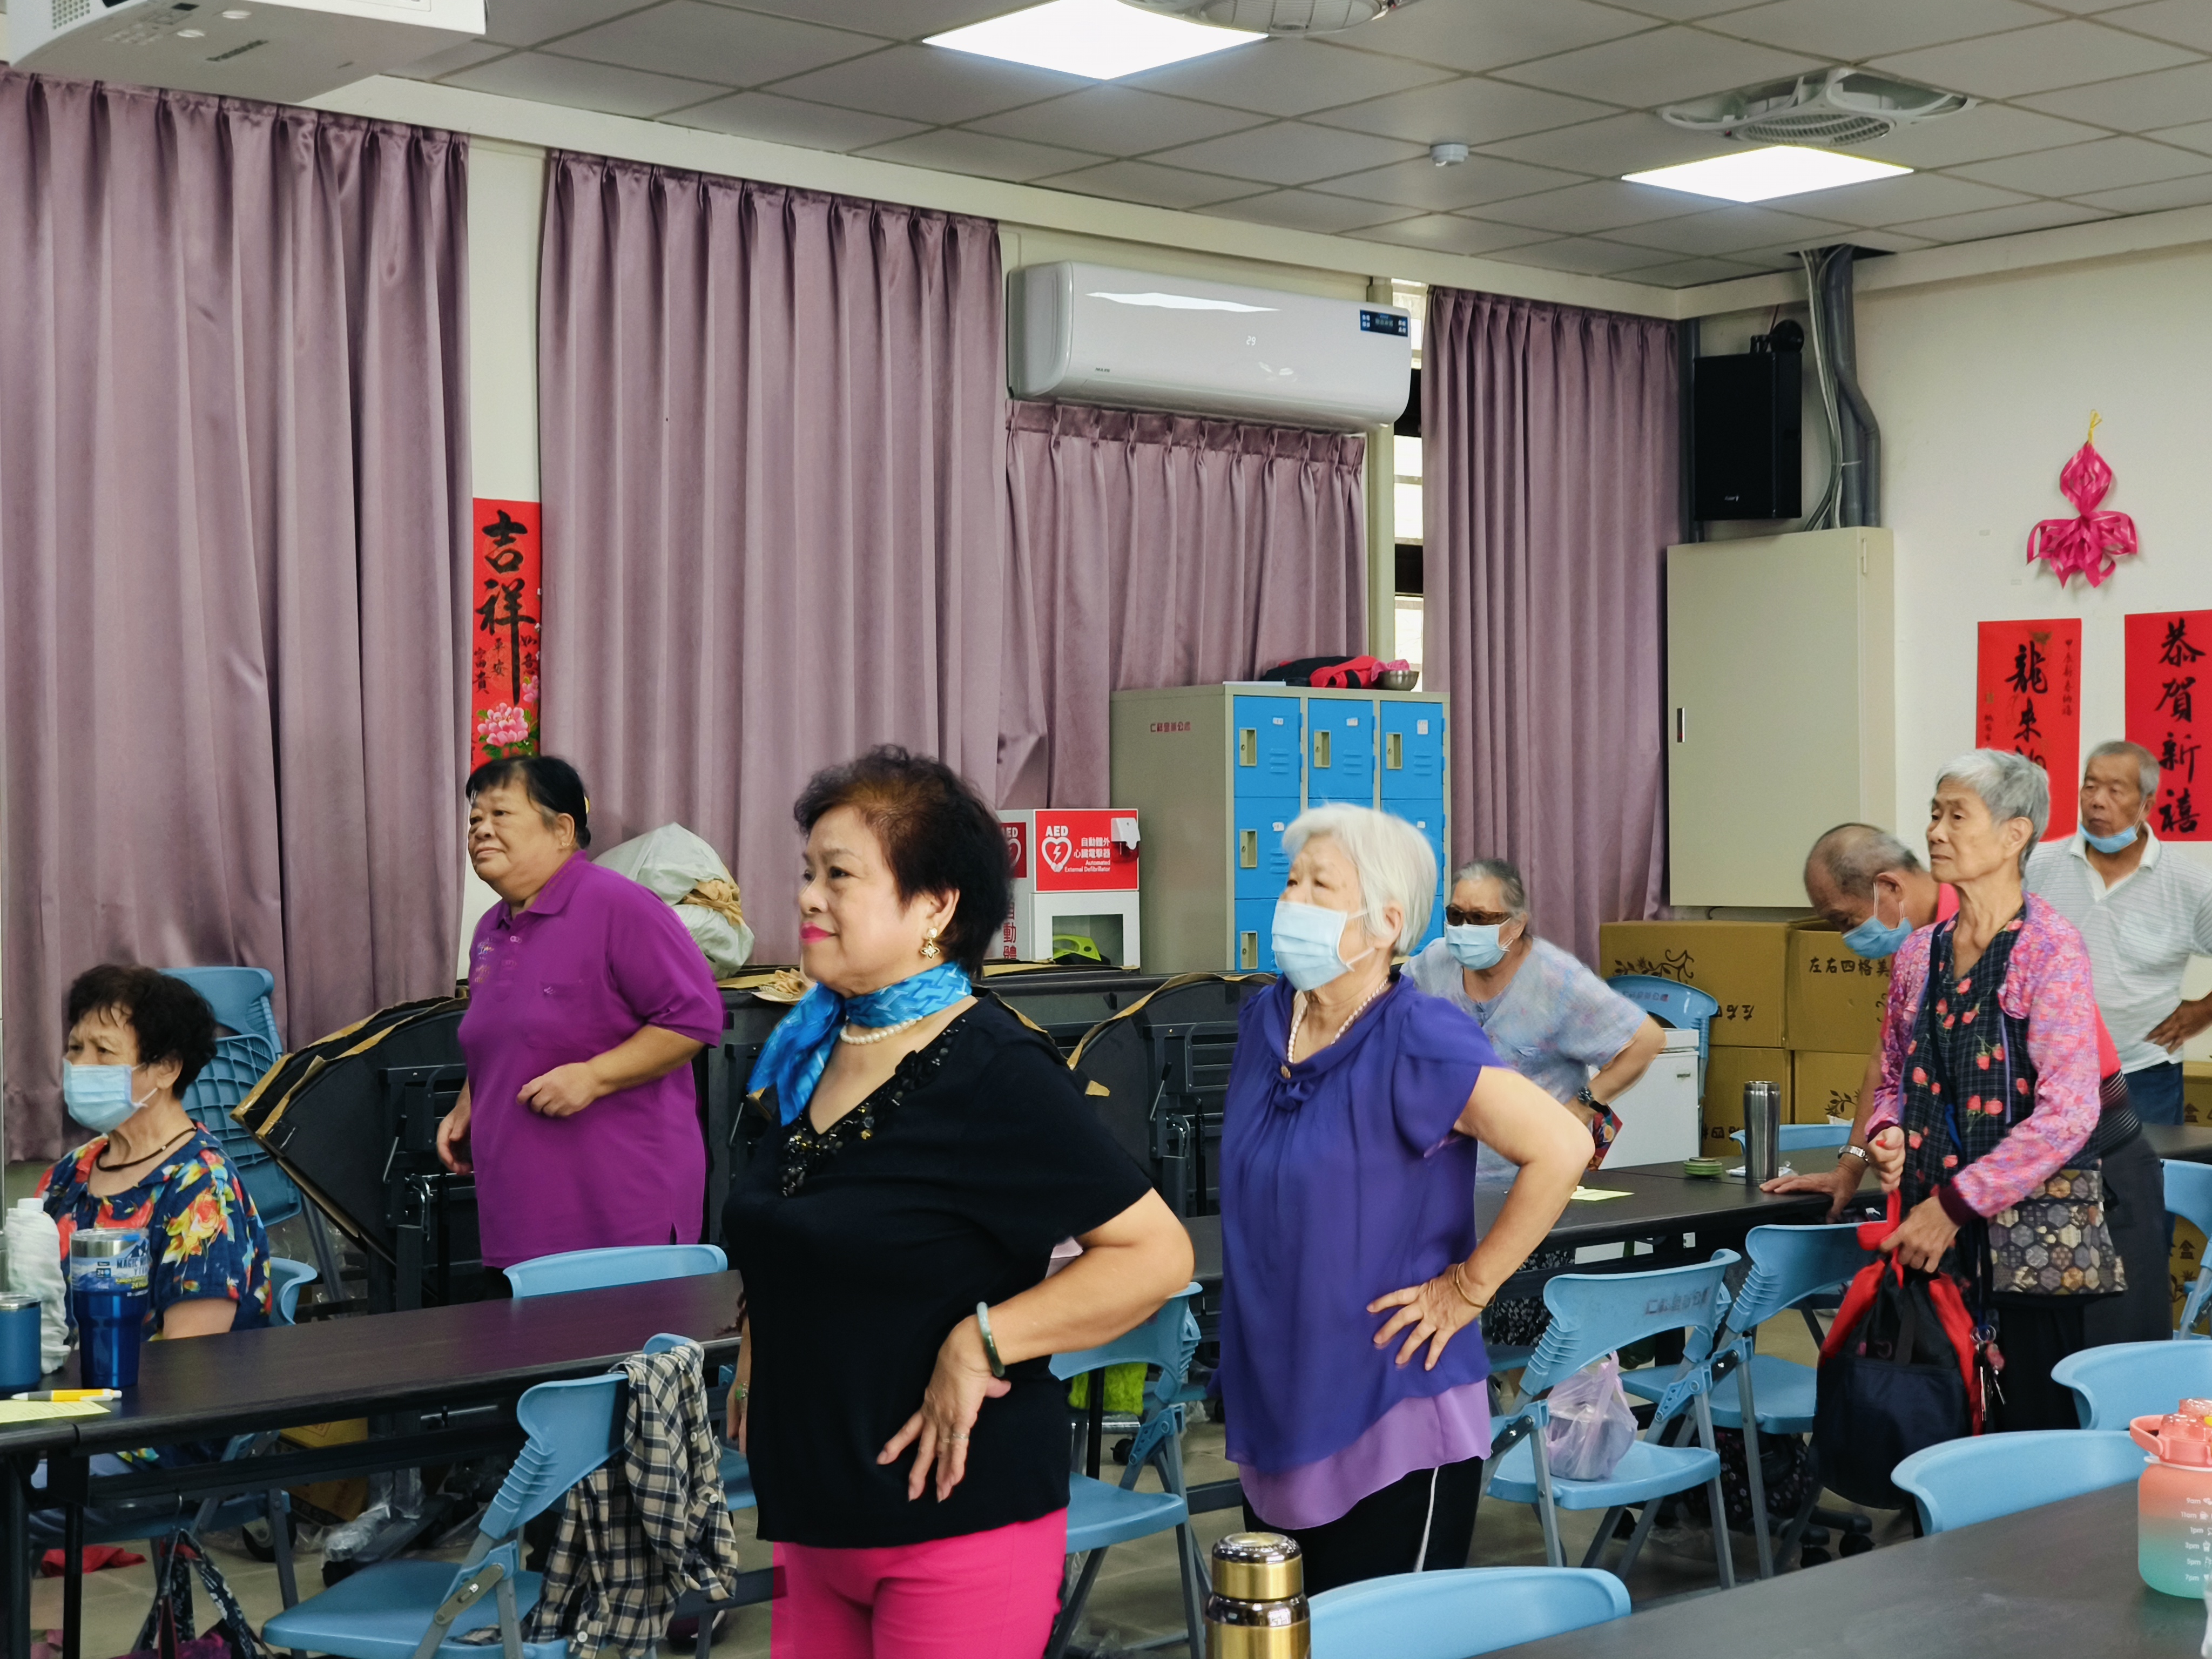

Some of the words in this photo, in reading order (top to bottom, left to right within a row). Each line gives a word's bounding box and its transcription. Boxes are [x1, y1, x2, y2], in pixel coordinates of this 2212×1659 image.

[1246, 335, 1256, 346] 29
[475, 509, 537, 706] 吉祥
[473, 646, 491, 694] 富貴
[491, 637, 509, 677] 平安
[520, 635, 538, 675] 如意
[2154, 617, 2206, 833] 恭賀新禧
[1046, 826, 1069, 837] AED
[1081, 837, 1110, 847] 自動體外
[1073, 848, 1110, 858] 心臟電擊器
[1809, 956, 1890, 977] 左右四格美
